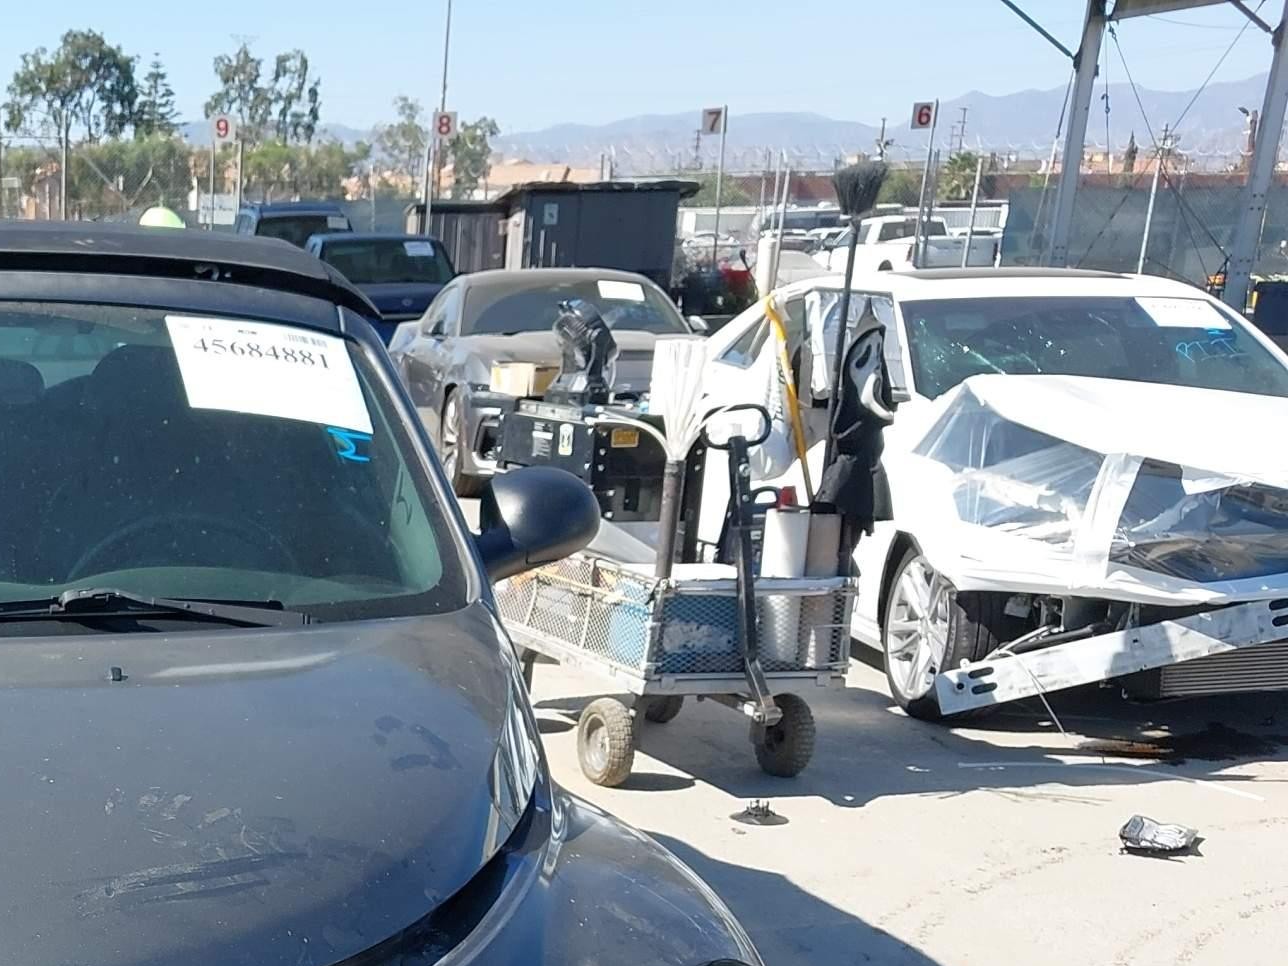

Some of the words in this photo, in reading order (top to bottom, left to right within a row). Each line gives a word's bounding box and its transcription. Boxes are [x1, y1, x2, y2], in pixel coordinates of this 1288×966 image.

[439, 115, 450, 135] 8
[708, 111, 722, 132] 7
[918, 105, 931, 125] 6
[216, 118, 229, 138] 9
[193, 337, 330, 369] 45684881
